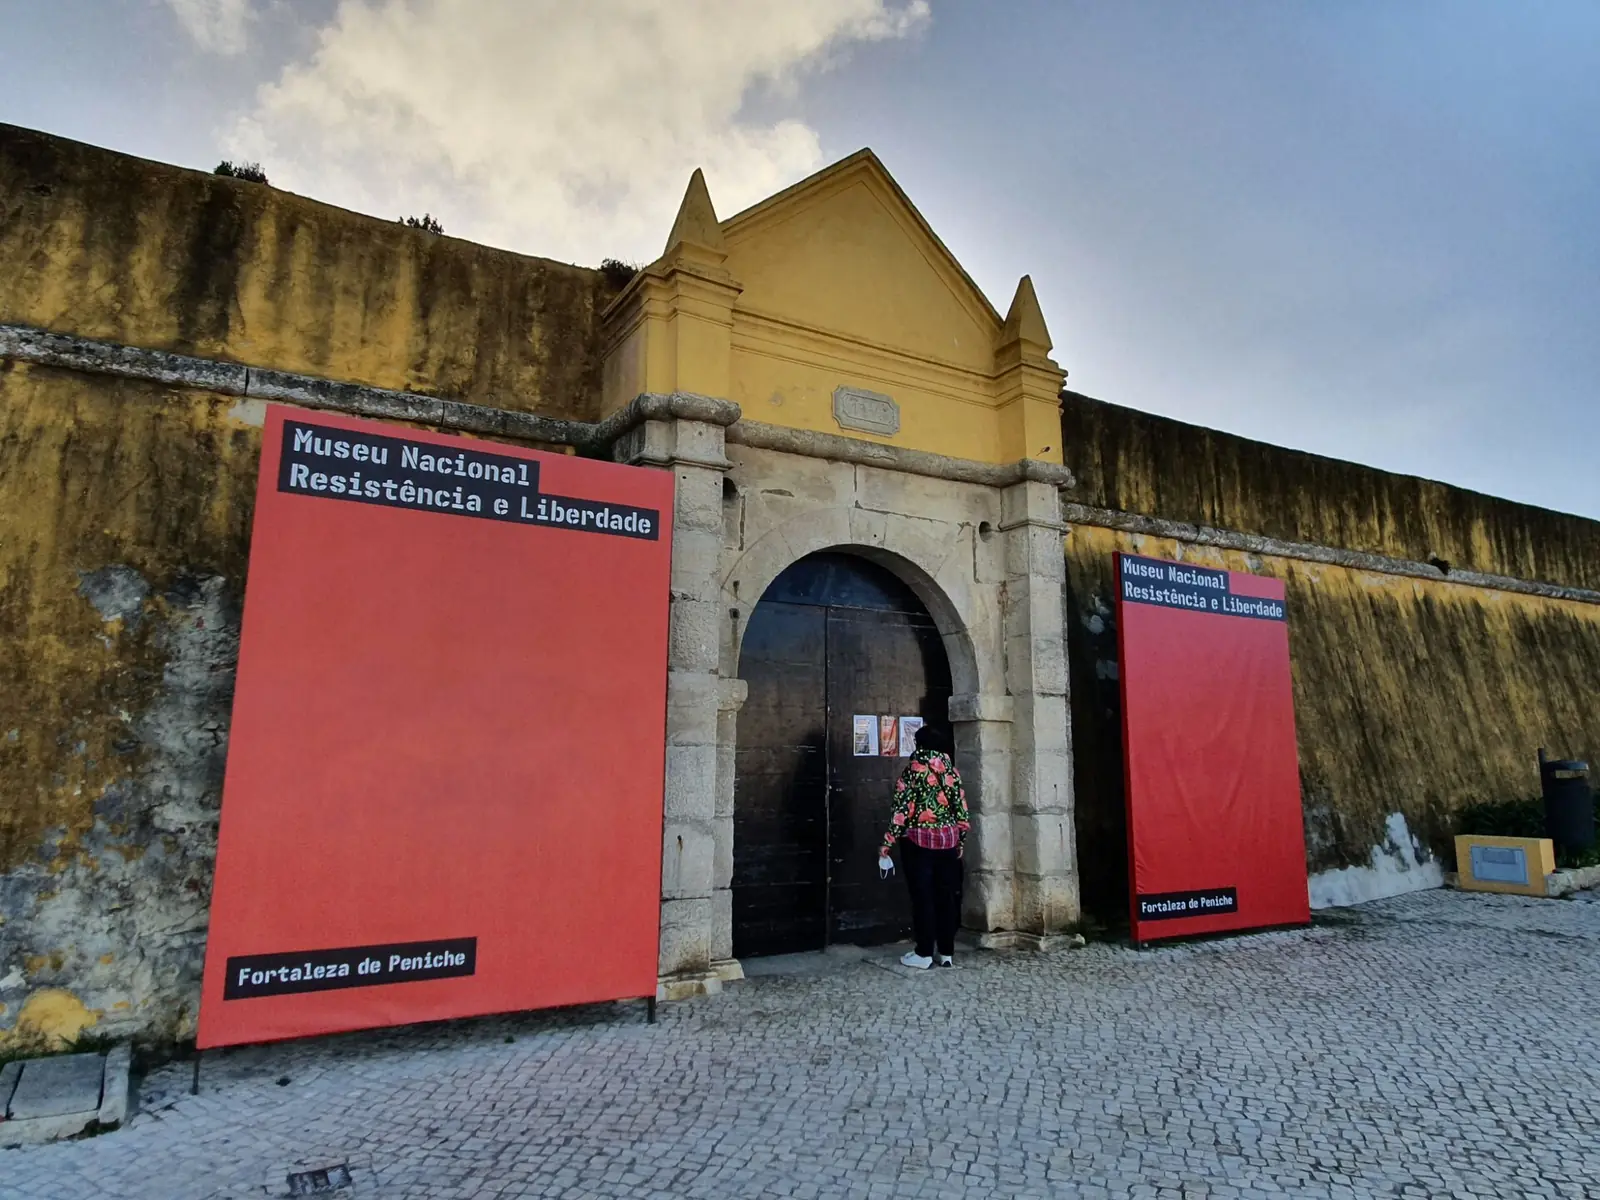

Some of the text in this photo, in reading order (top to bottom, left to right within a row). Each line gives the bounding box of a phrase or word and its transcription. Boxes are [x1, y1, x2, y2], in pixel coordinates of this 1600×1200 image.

[294, 428, 530, 487] Museu Nacional
[289, 463, 652, 534] Resistência e Liberdade
[1123, 557, 1226, 589] Museu Nacional
[1124, 581, 1283, 618] Resistência e Liberdade
[1141, 895, 1233, 913] Fortaleza de Peniche
[238, 950, 466, 986] Fortaleza de Peniche
